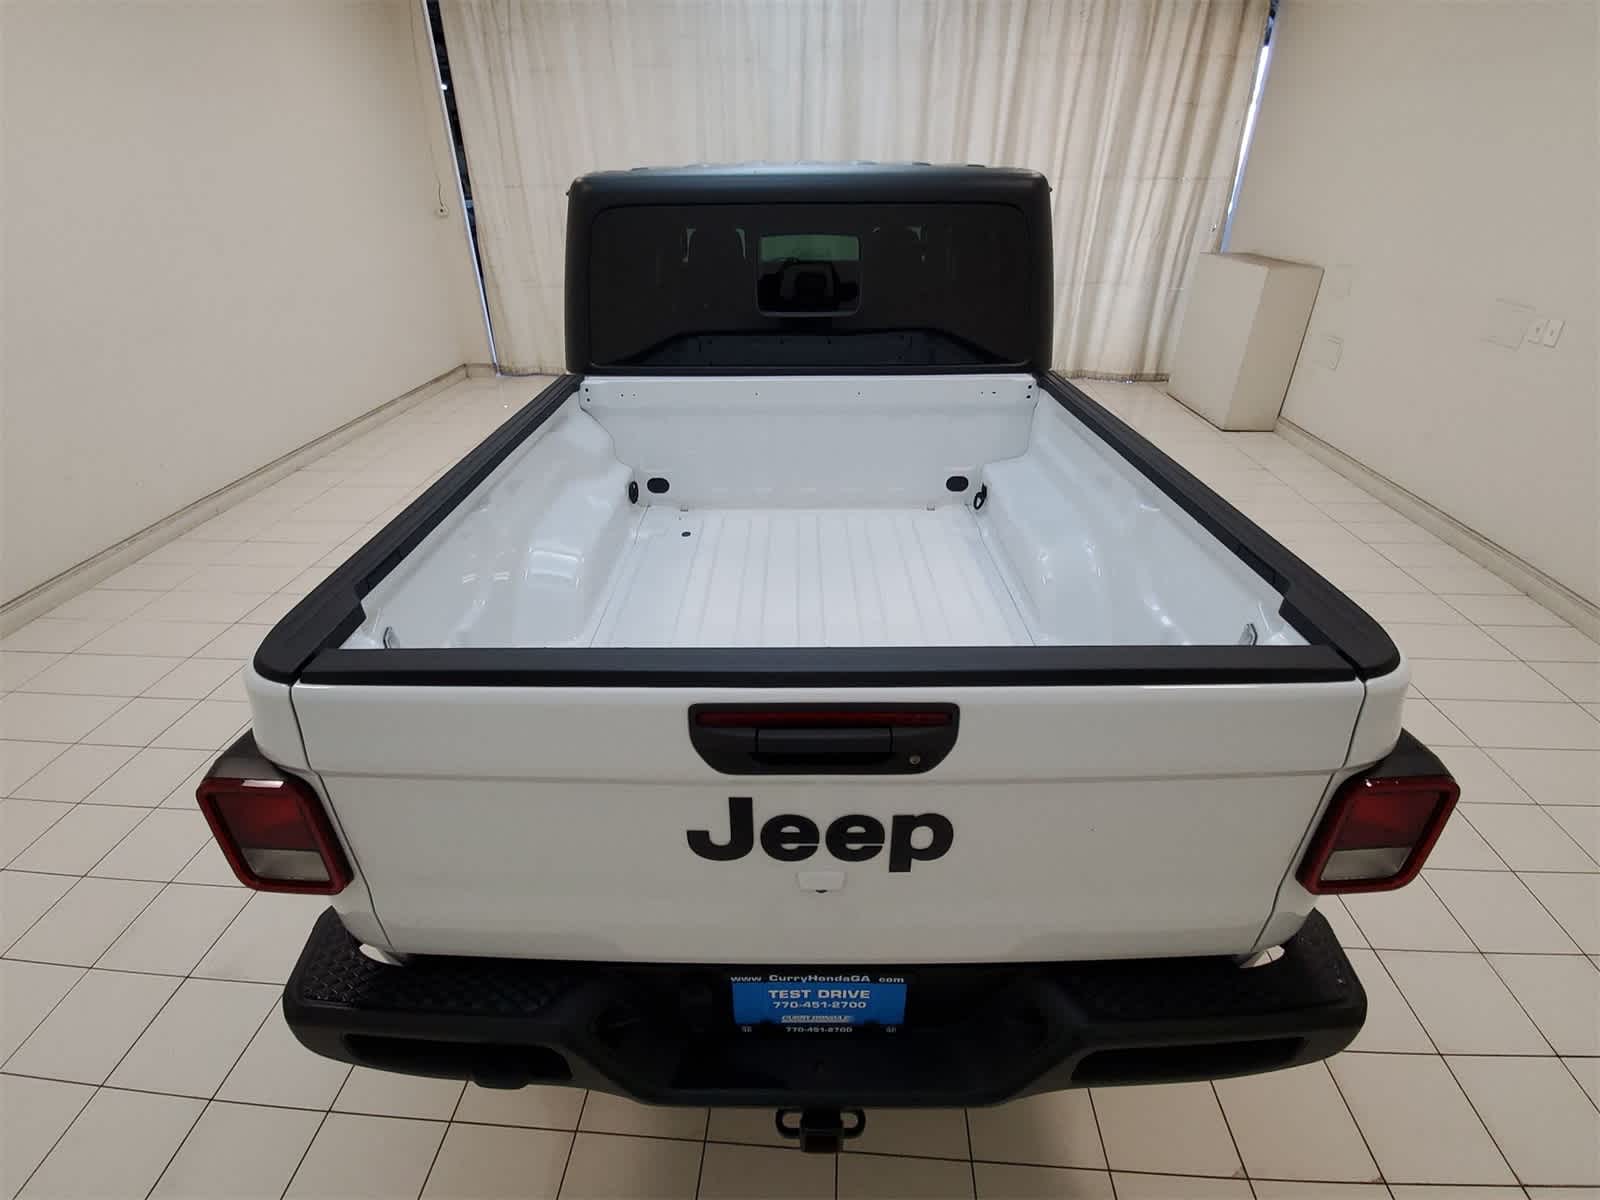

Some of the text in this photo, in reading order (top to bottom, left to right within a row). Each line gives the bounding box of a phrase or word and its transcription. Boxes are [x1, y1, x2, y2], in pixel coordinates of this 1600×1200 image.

[686, 797, 954, 873] Jeep
[768, 989, 871, 999] TEST DRIVE
[773, 1001, 867, 1009] 770-451-2700
